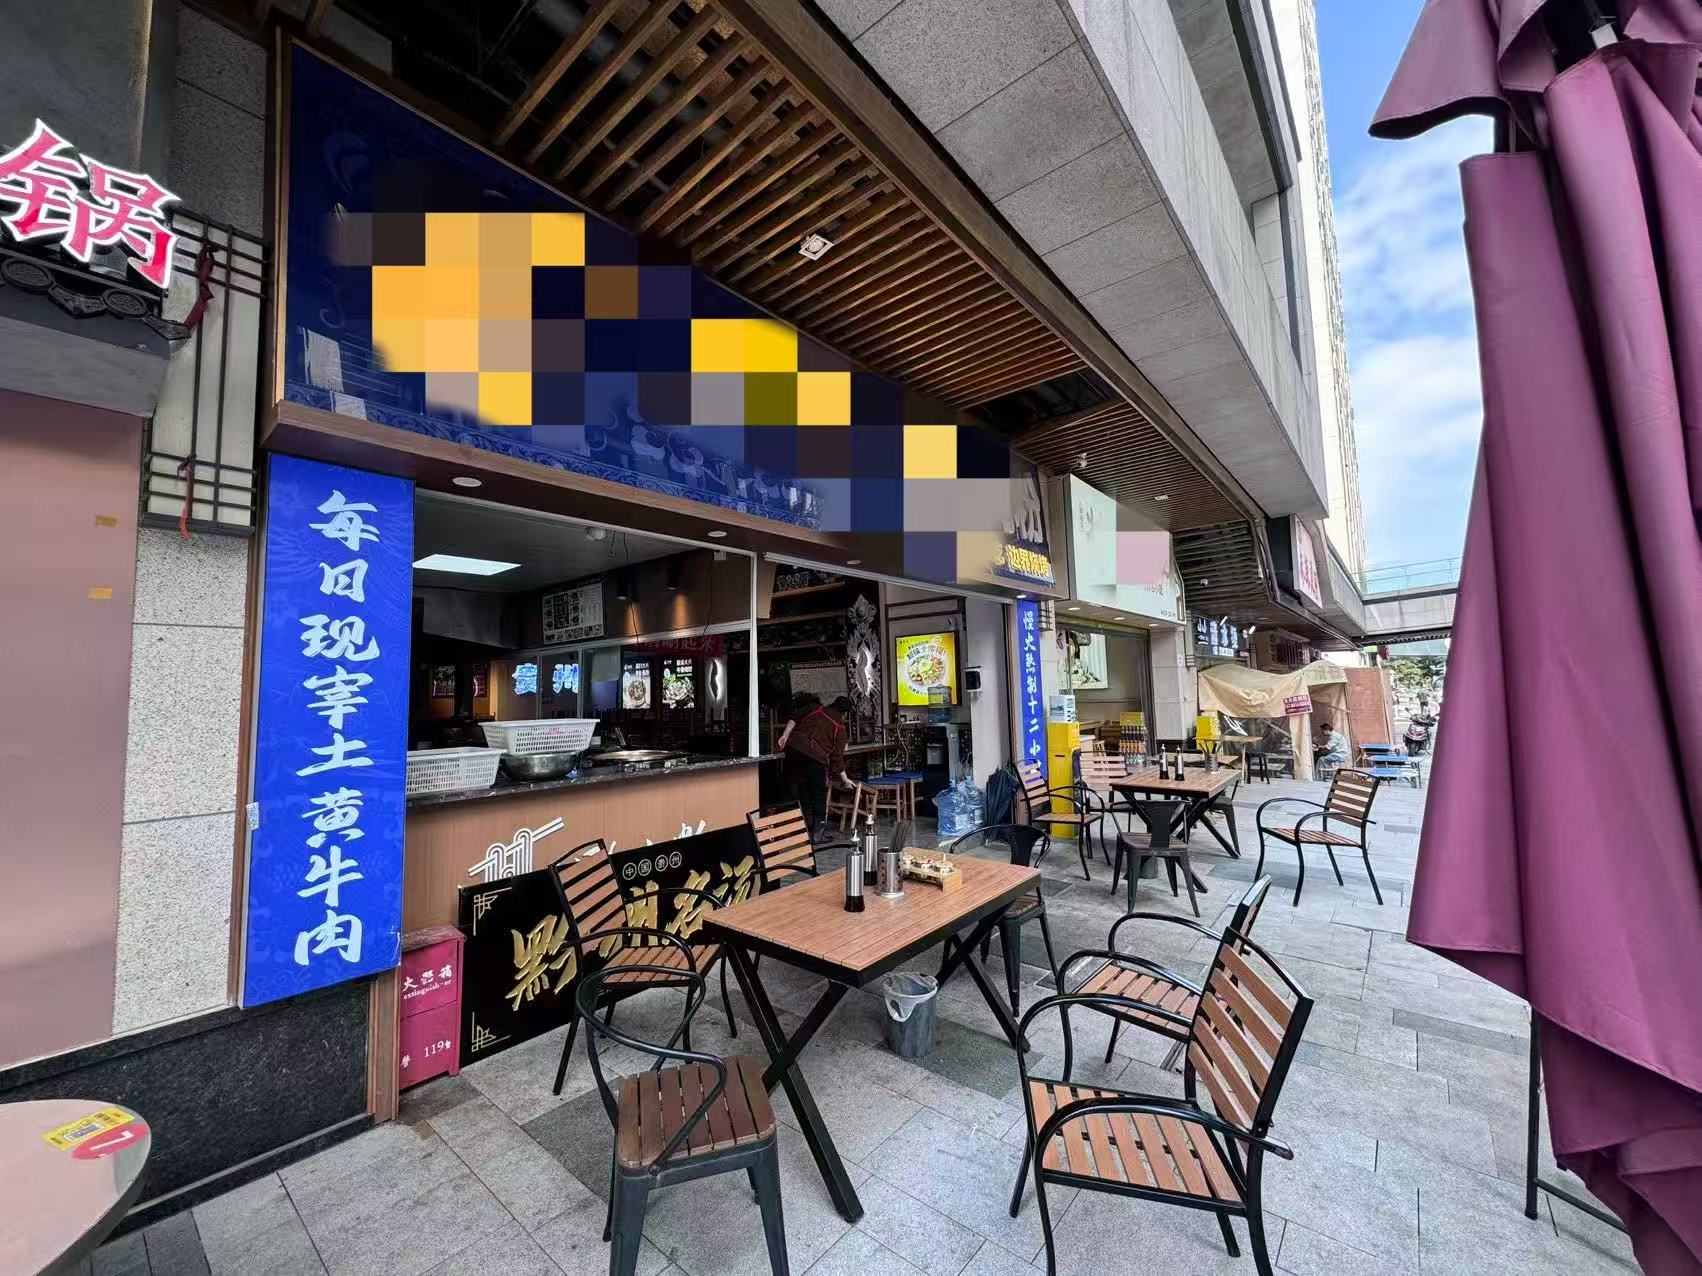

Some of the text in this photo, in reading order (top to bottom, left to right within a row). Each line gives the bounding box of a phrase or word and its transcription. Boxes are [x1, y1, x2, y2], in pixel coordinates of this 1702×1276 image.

[0, 118, 181, 288] 锅
[293, 489, 381, 966] 每日现宰土黄牛肉
[1022, 610, 1042, 774] 慢火熬制十二小
[622, 852, 682, 880] 中国贵州
